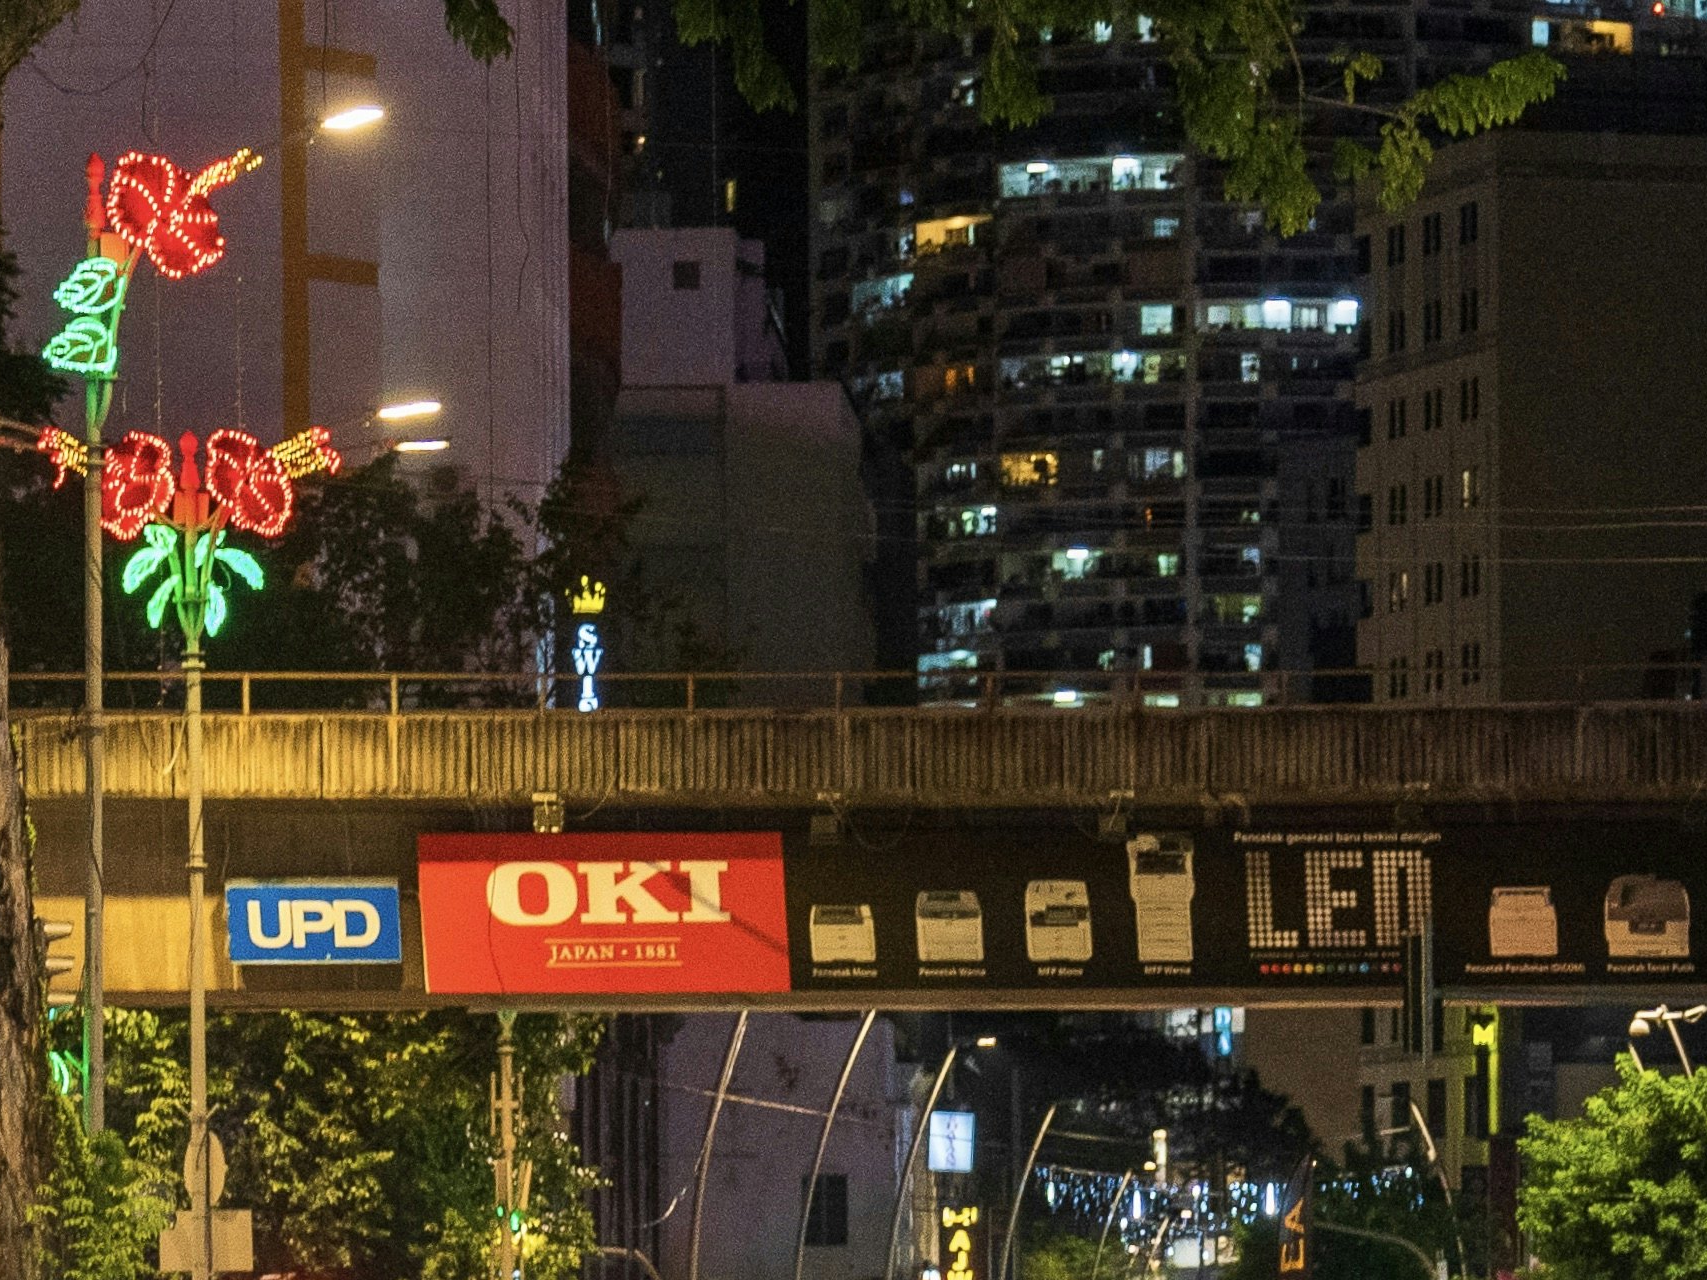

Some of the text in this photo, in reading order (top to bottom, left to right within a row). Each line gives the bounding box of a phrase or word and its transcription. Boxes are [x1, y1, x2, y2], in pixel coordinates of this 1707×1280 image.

[485, 861, 731, 926] OKI
[246, 899, 380, 948] UPD
[547, 943, 679, 965] JAPAN 1881
